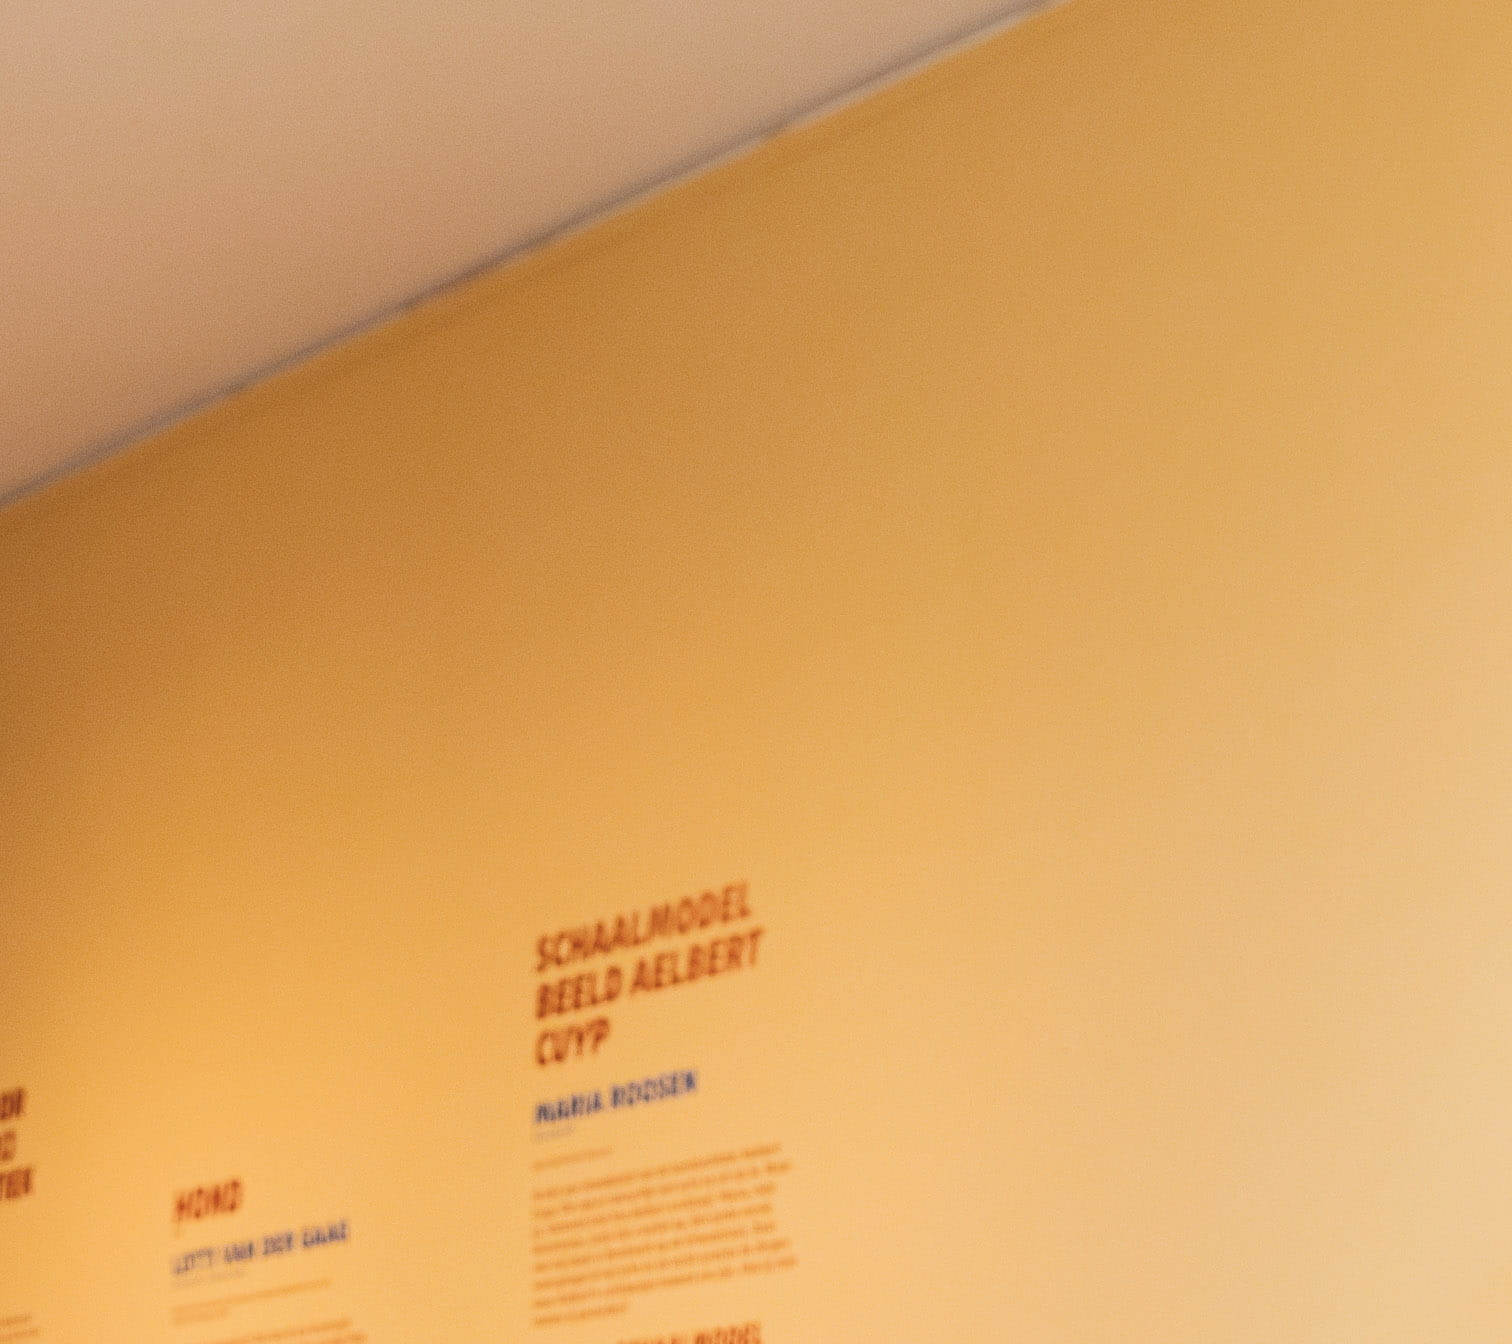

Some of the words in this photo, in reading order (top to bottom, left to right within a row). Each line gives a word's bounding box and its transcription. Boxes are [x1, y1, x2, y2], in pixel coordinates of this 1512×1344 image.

[536, 880, 751, 973] SCHAALMODEL
[536, 966, 623, 1020] BEELD
[630, 926, 764, 995] AELBERT
